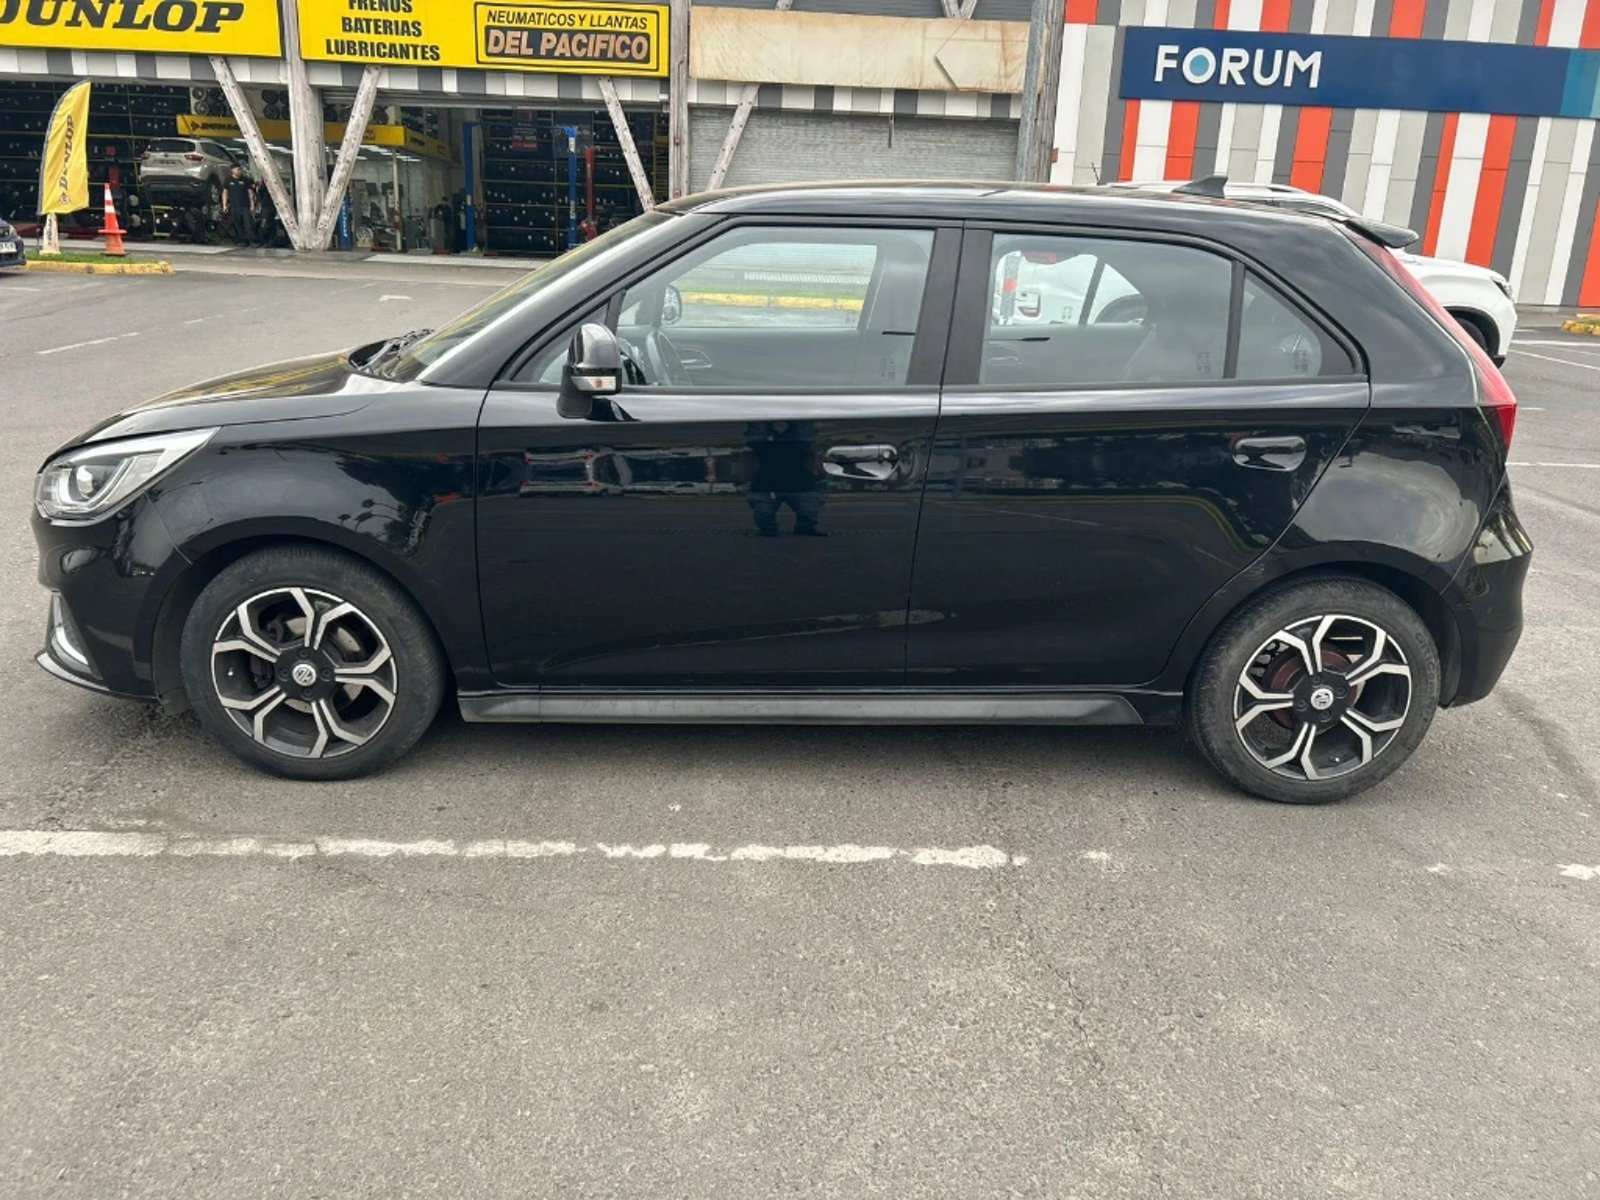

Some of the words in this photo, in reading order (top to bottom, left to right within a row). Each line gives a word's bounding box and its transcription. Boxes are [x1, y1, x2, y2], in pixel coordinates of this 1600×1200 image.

[348, 0, 413, 13] FRENOS
[341, 16, 422, 37] BATERIAS
[487, 10, 576, 27] NEUMATICOS
[578, 14, 587, 27] Y
[589, 15, 648, 30] LLANTAS
[325, 38, 440, 61] LUBRICANTES
[487, 29, 534, 56] DEL
[540, 32, 649, 61] PACIFICO
[1154, 44, 1322, 89] FORUM
